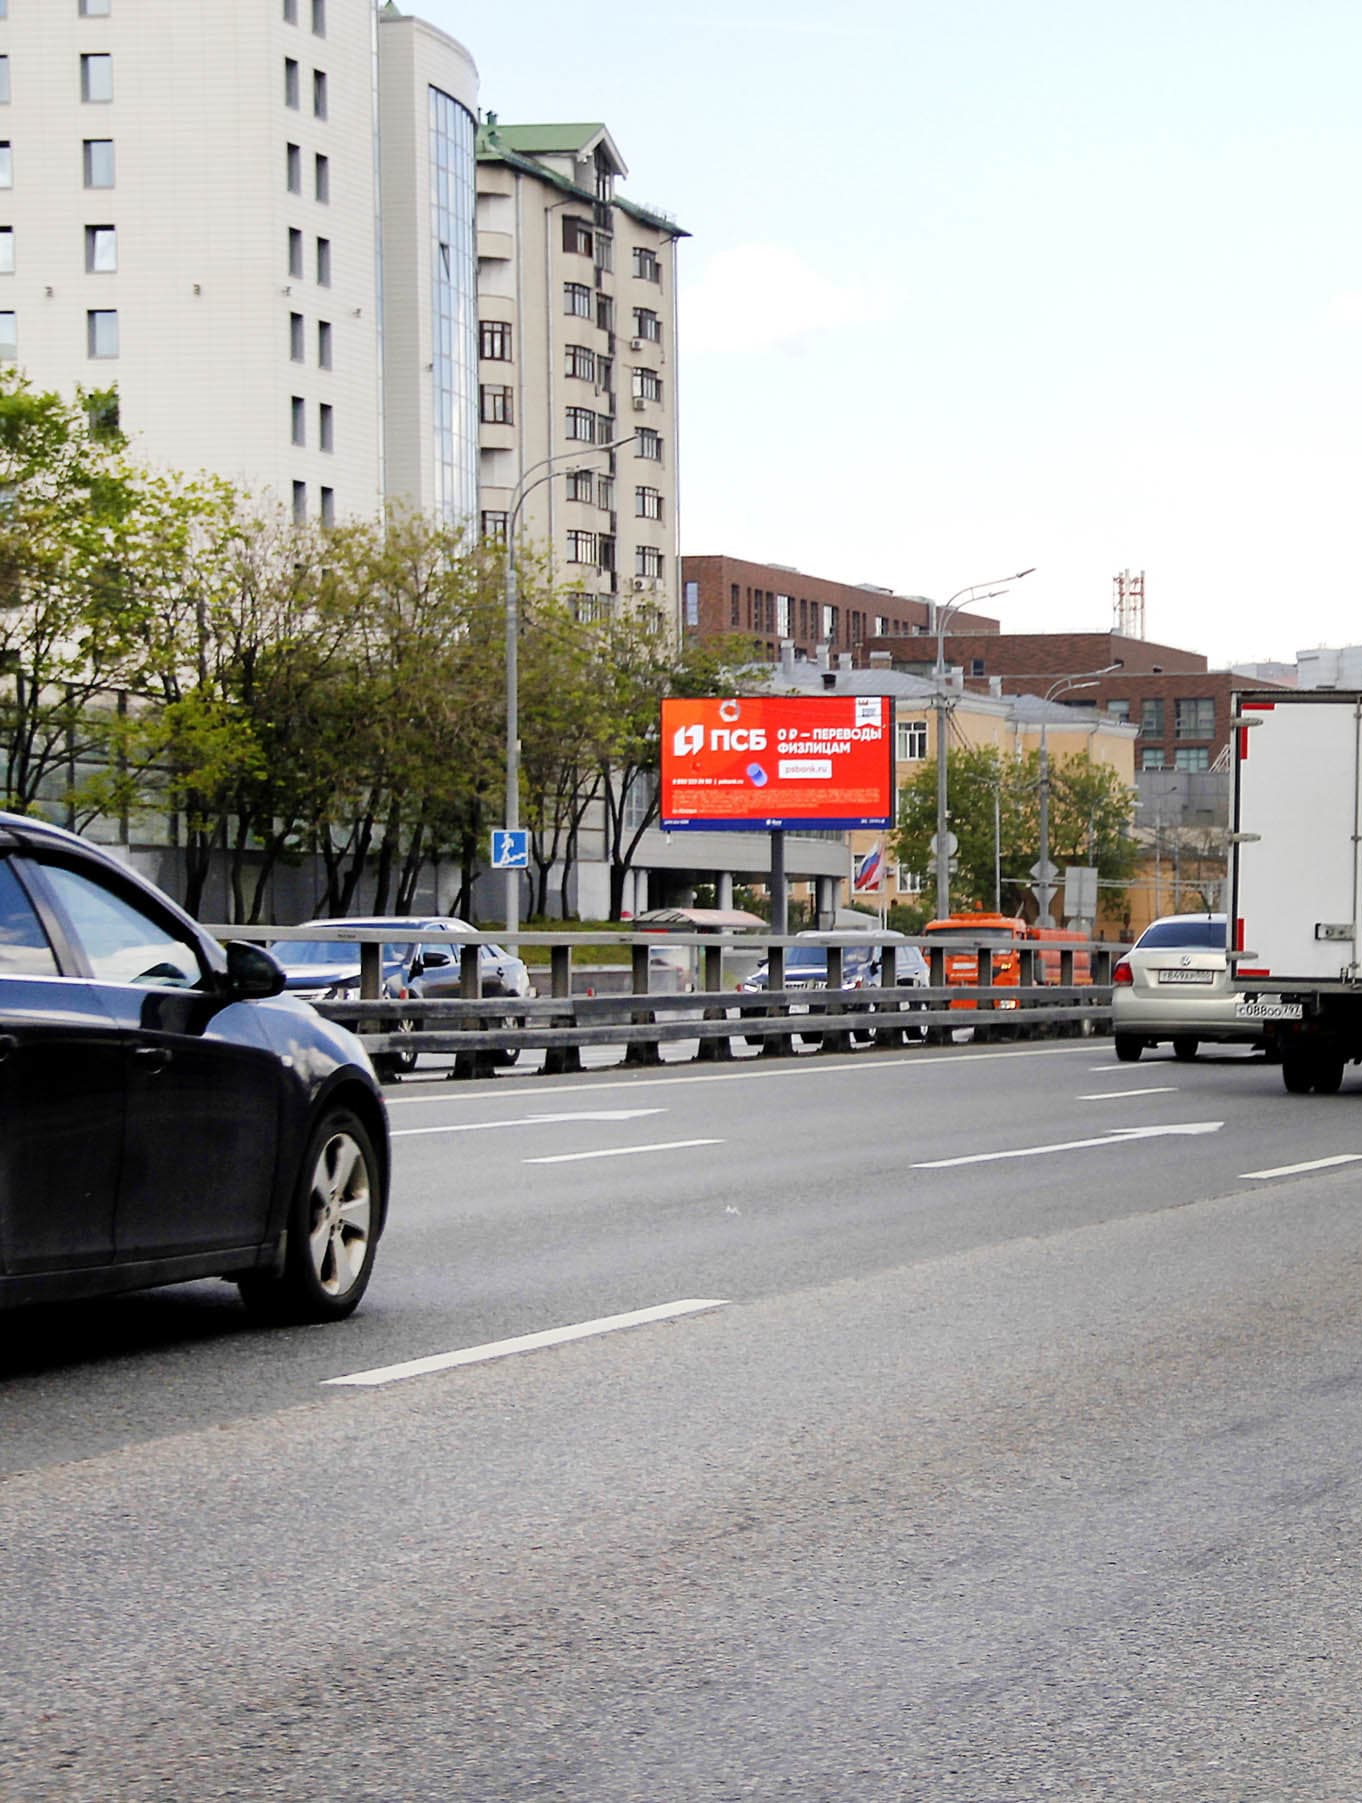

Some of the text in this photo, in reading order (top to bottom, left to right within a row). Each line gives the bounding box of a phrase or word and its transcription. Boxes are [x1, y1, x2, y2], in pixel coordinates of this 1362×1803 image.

[711, 728, 767, 752] ПСБ
[812, 727, 882, 742] ПЕРЕВОДЫ
[777, 741, 851, 755] ФИЗЛИЦАМ
[785, 765, 828, 775] psbank.ru
